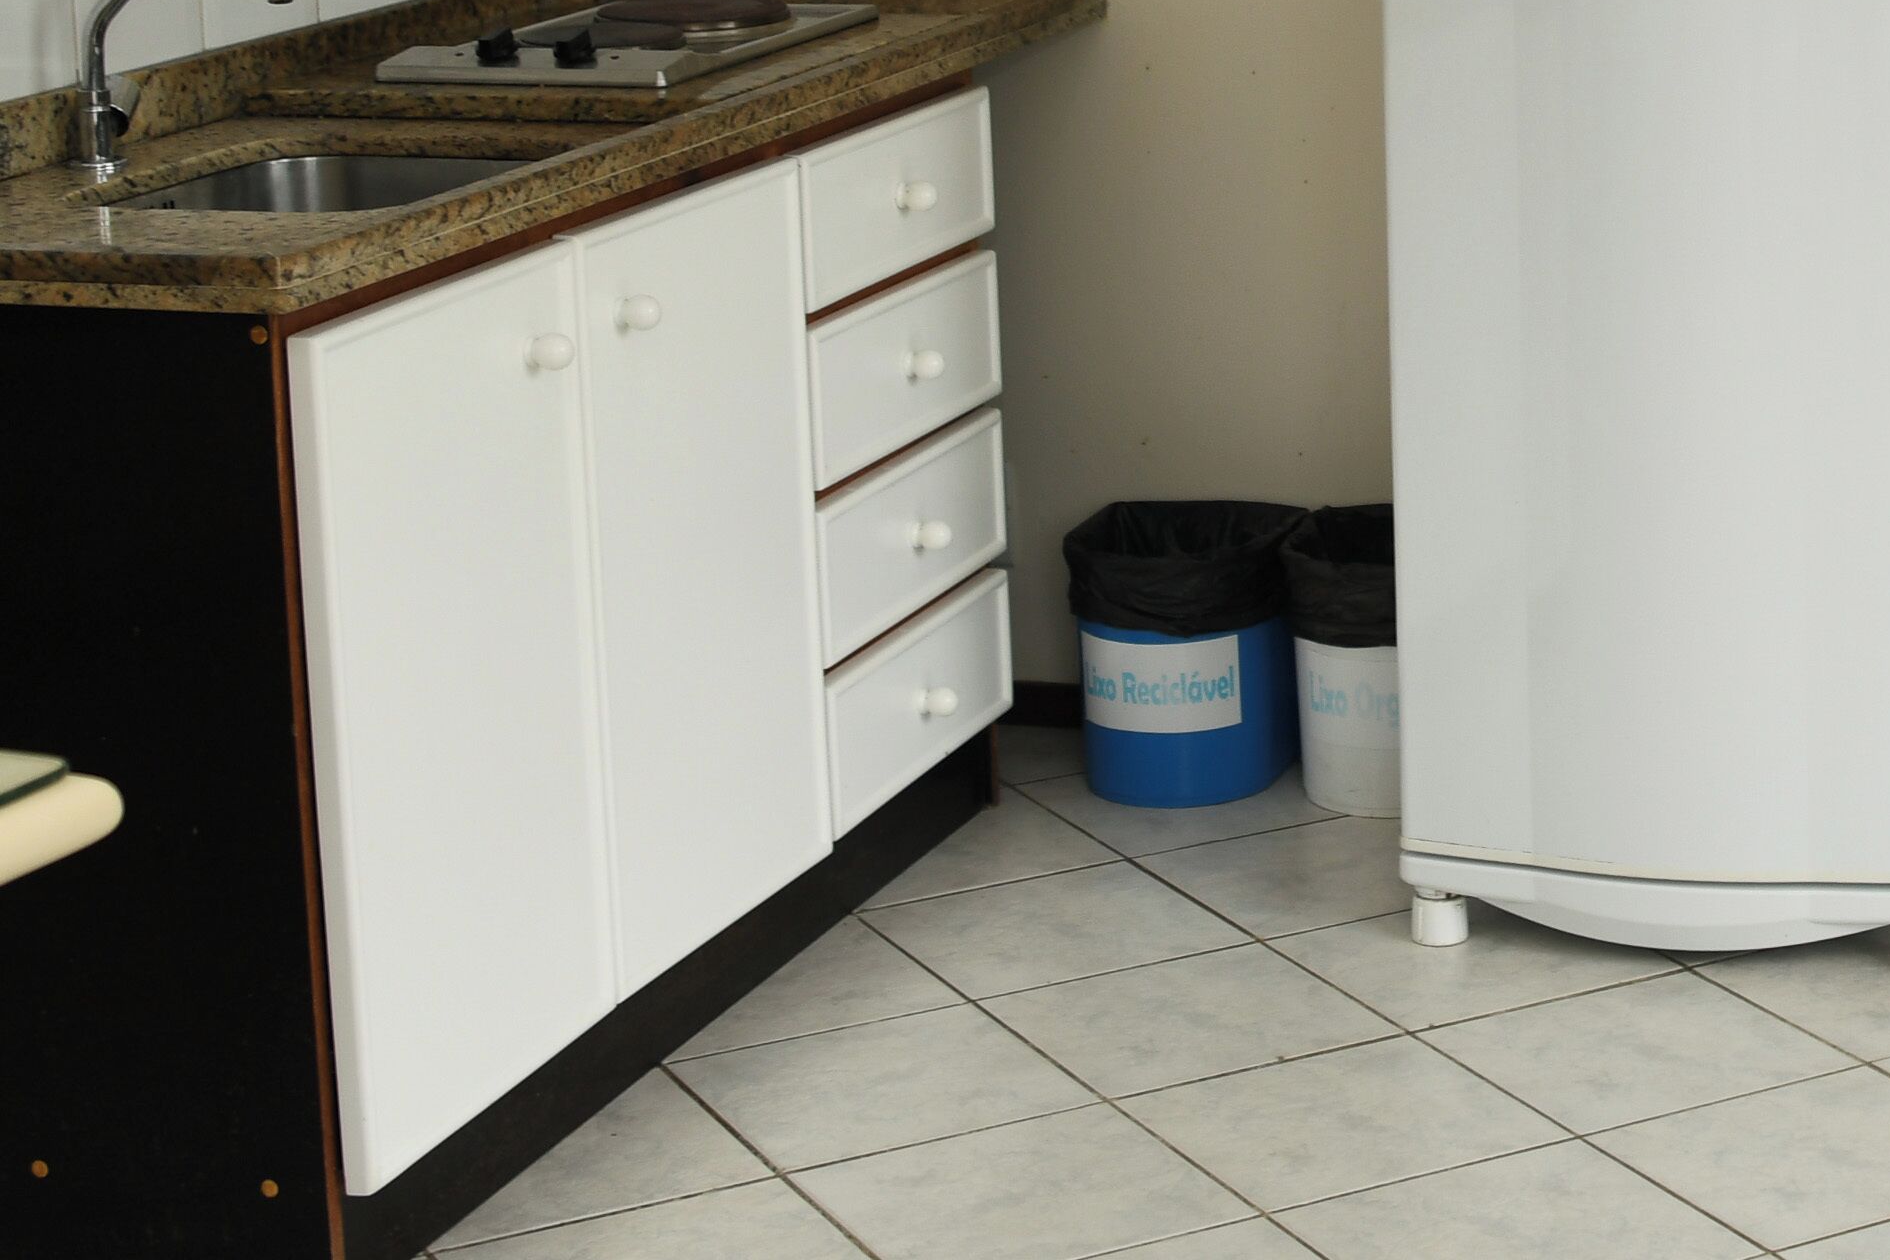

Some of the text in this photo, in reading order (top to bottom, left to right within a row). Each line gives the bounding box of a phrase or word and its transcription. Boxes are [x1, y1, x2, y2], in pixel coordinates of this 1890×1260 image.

[1086, 662, 1235, 706] Lixo Reciclável
[1309, 670, 1347, 717] Lixo
